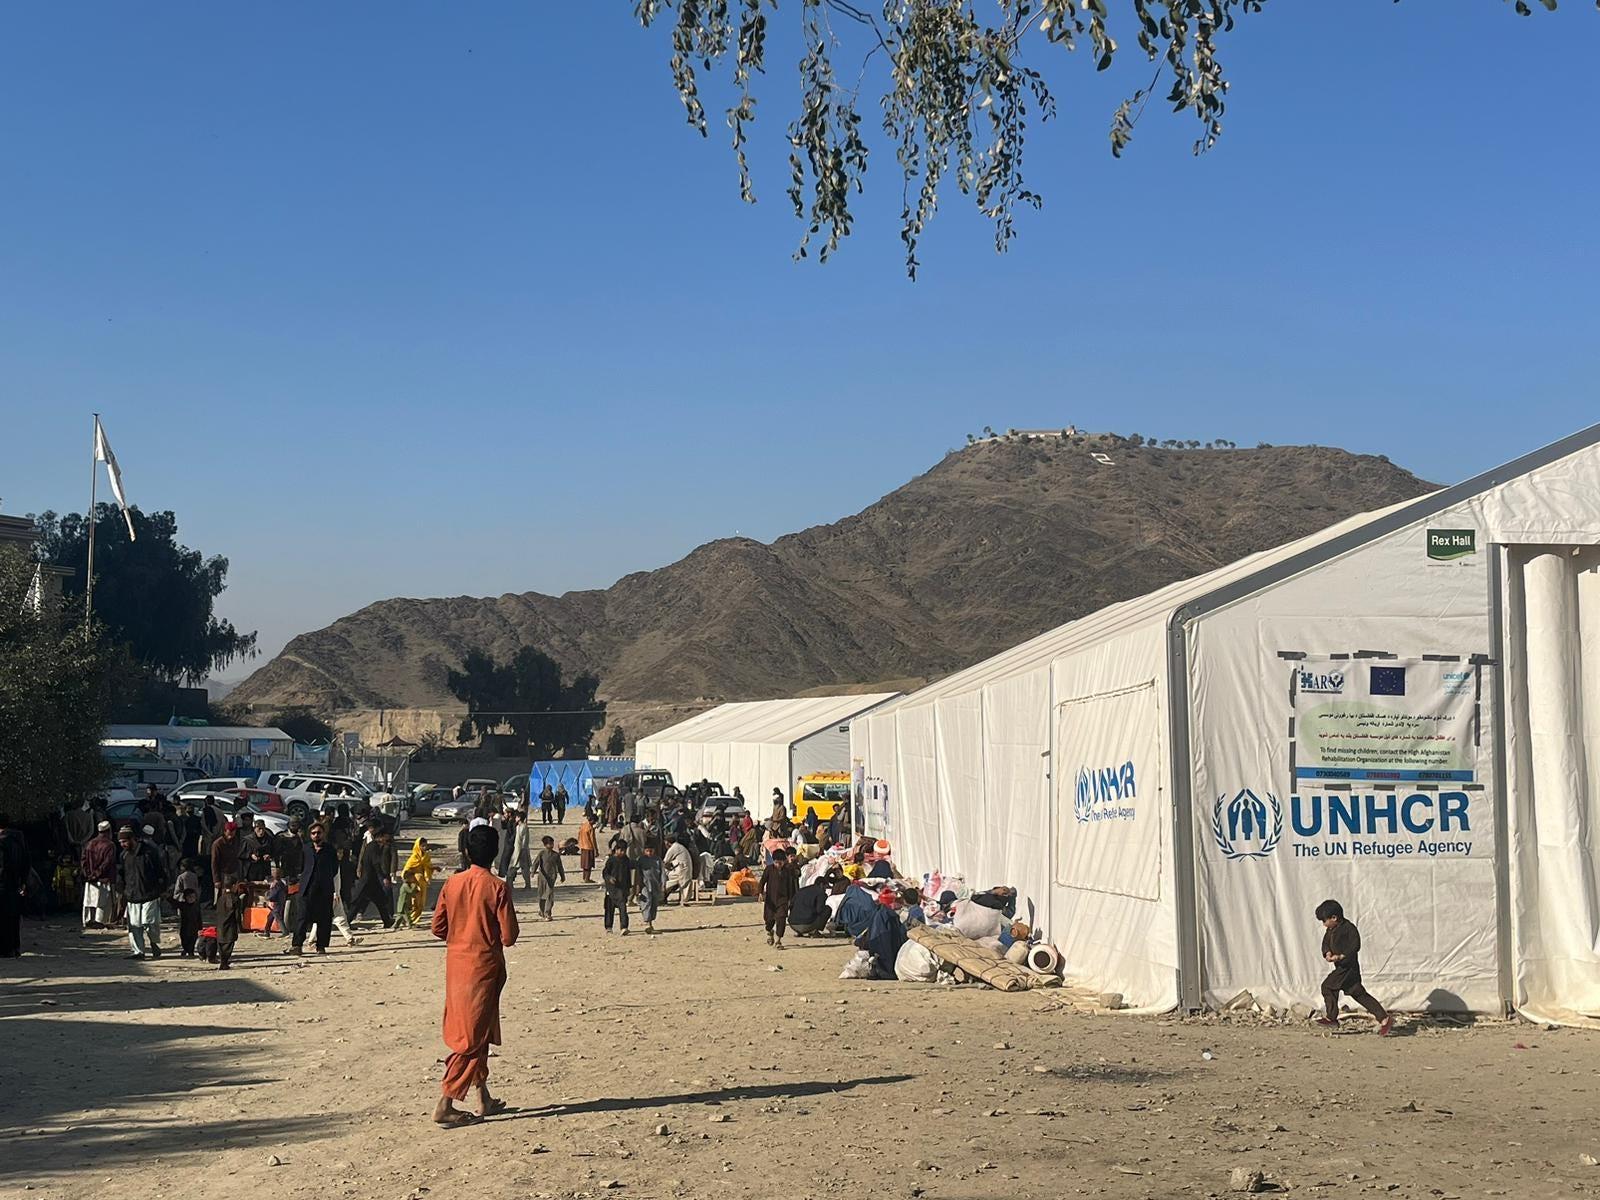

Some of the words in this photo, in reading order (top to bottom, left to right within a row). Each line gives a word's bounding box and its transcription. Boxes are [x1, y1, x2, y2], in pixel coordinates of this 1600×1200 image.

[1431, 535, 1450, 546] Rex
[1452, 535, 1471, 546] Hall
[1337, 747, 1357, 755] missing
[1408, 748, 1419, 756] High
[1420, 748, 1451, 757] Afghanistan
[1321, 755, 1356, 763] Rehabilitation
[1356, 756, 1388, 764] Organization
[1403, 757, 1428, 765] following
[1290, 791, 1471, 837] UNHCR
[1292, 843, 1320, 857] The
[1325, 841, 1348, 856] UN
[1352, 841, 1413, 858] Refugee
[1417, 839, 1472, 857] Agency
